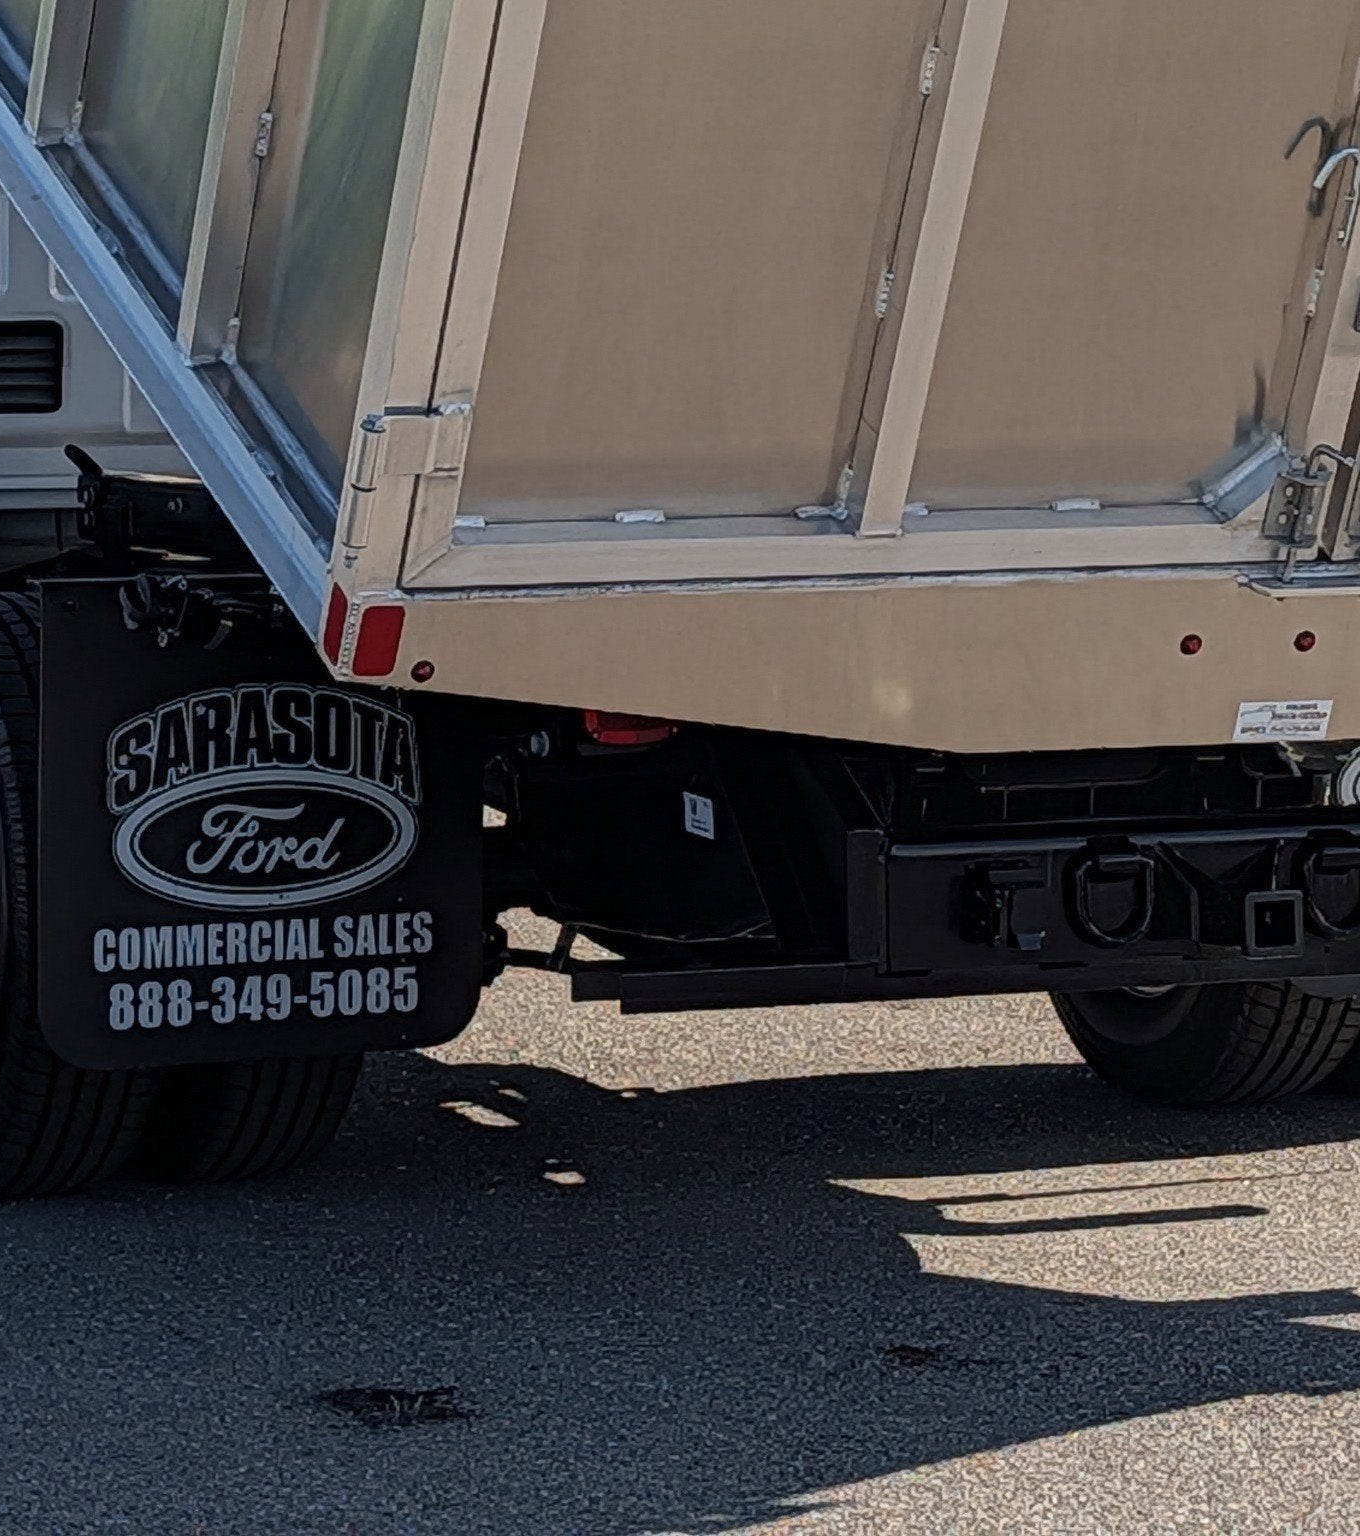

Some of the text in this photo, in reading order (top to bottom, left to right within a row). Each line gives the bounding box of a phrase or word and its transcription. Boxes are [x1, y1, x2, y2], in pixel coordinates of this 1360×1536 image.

[106, 682, 423, 815] SARASOTA
[186, 802, 346, 874] Ford
[93, 911, 434, 973] COMMERCIAL SALES
[109, 966, 420, 1031] 888-349-5085
